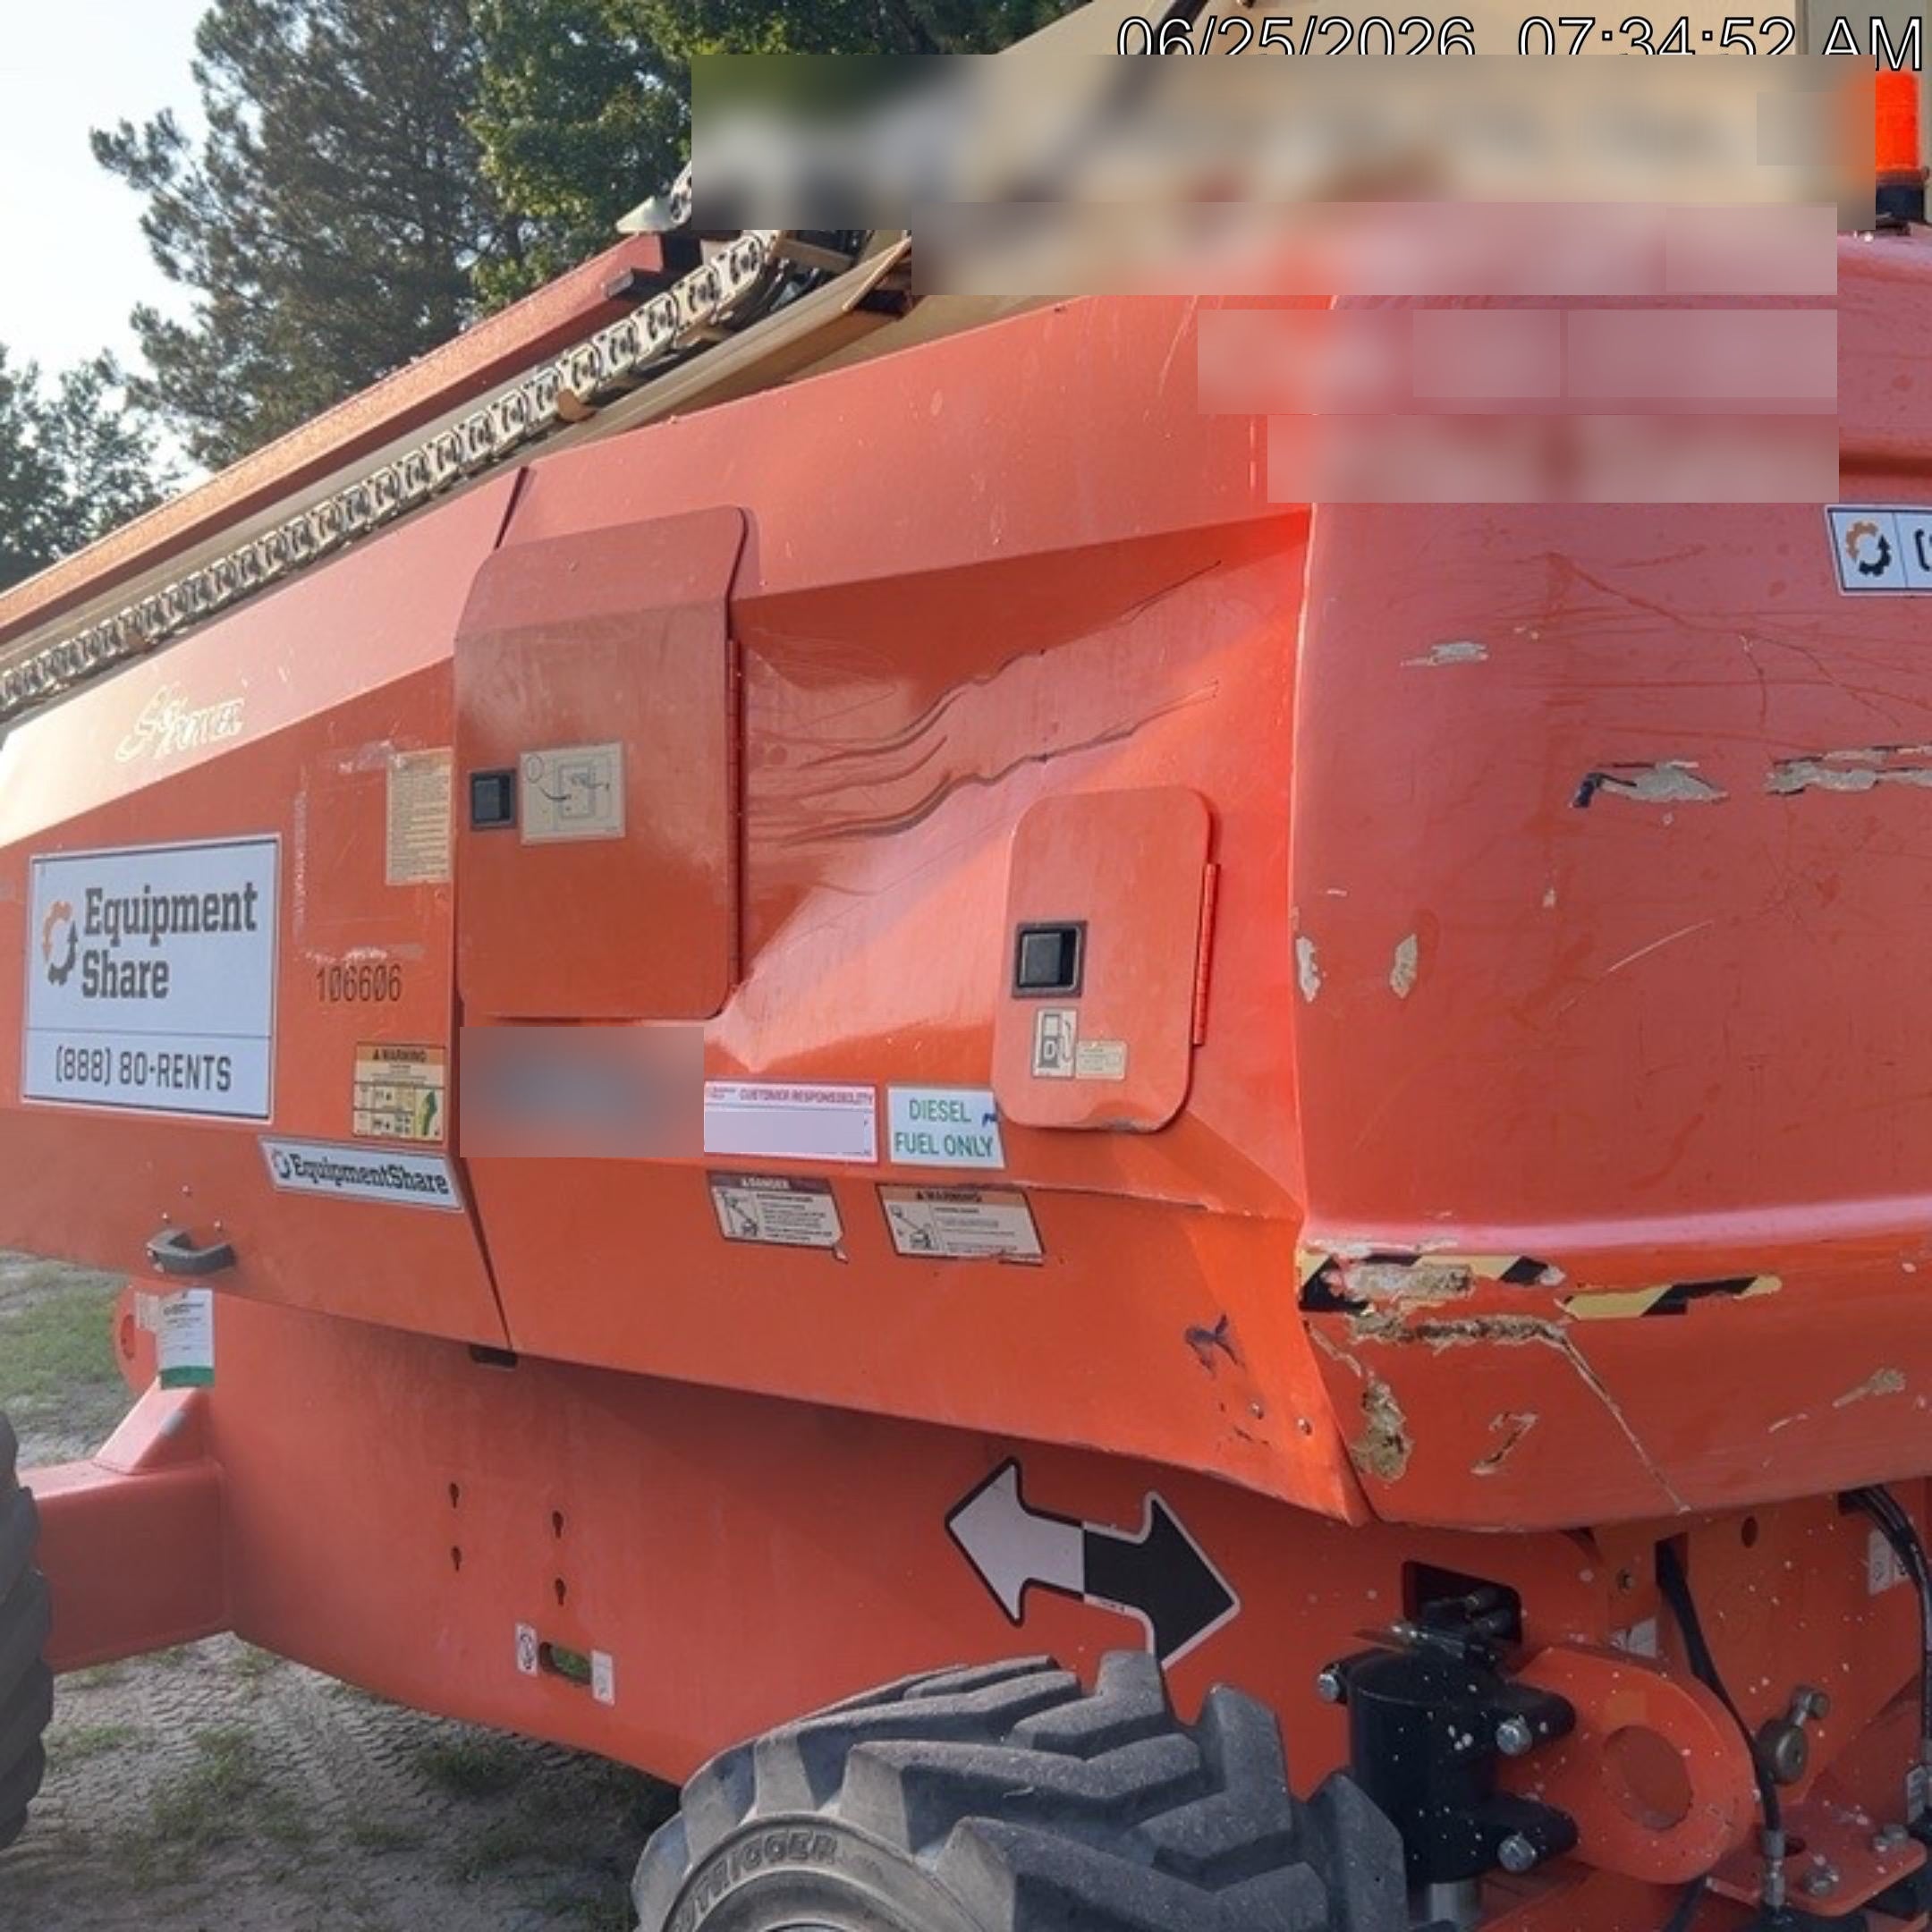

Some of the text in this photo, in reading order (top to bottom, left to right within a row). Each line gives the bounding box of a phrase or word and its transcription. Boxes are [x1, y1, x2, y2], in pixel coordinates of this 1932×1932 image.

[84, 882, 258, 946] Equipment
[81, 949, 169, 998] Share
[315, 964, 402, 1003] 106606
[55, 1045, 232, 1092] (888) 80-RENTS
[909, 1097, 972, 1123] DIESEL
[895, 1131, 939, 1155] FUEL
[944, 1134, 993, 1157] ONLY
[288, 1153, 449, 1195] EquipmentShare
